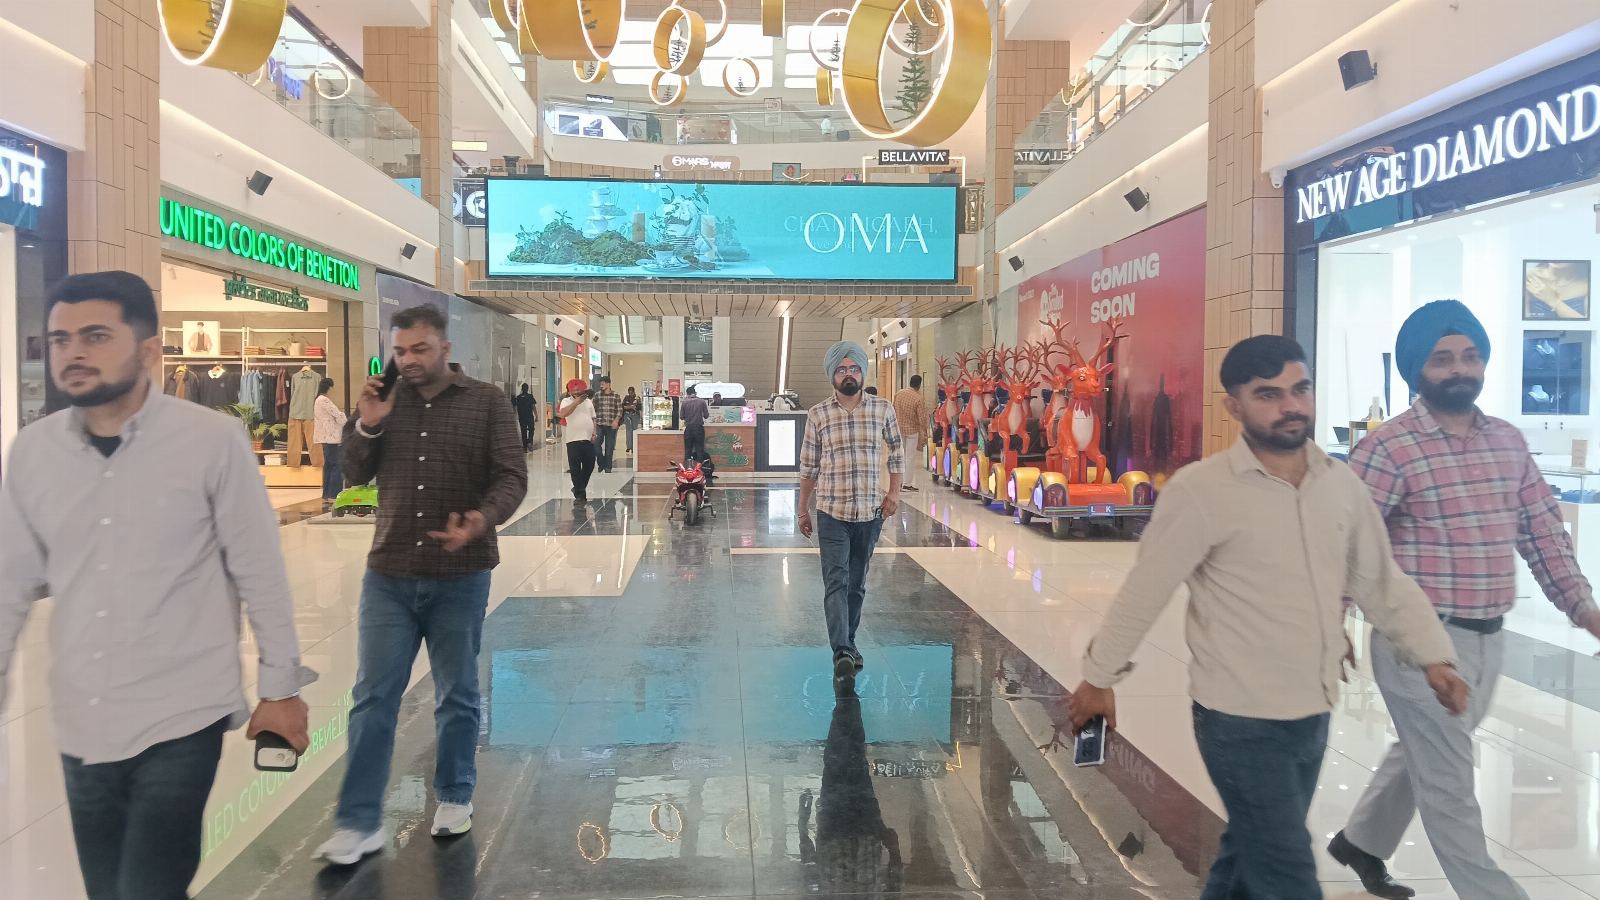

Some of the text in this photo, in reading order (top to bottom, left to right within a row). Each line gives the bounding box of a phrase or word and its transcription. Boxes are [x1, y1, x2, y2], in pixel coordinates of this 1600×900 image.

[1296, 84, 1600, 223] NEW AGE DIAMOND
[159, 196, 226, 250] UNITED
[229, 222, 286, 269] COLORS
[287, 242, 304, 273] OF
[804, 212, 929, 254] OMA
[1091, 252, 1160, 294] COMING
[1090, 292, 1136, 324] SOON
